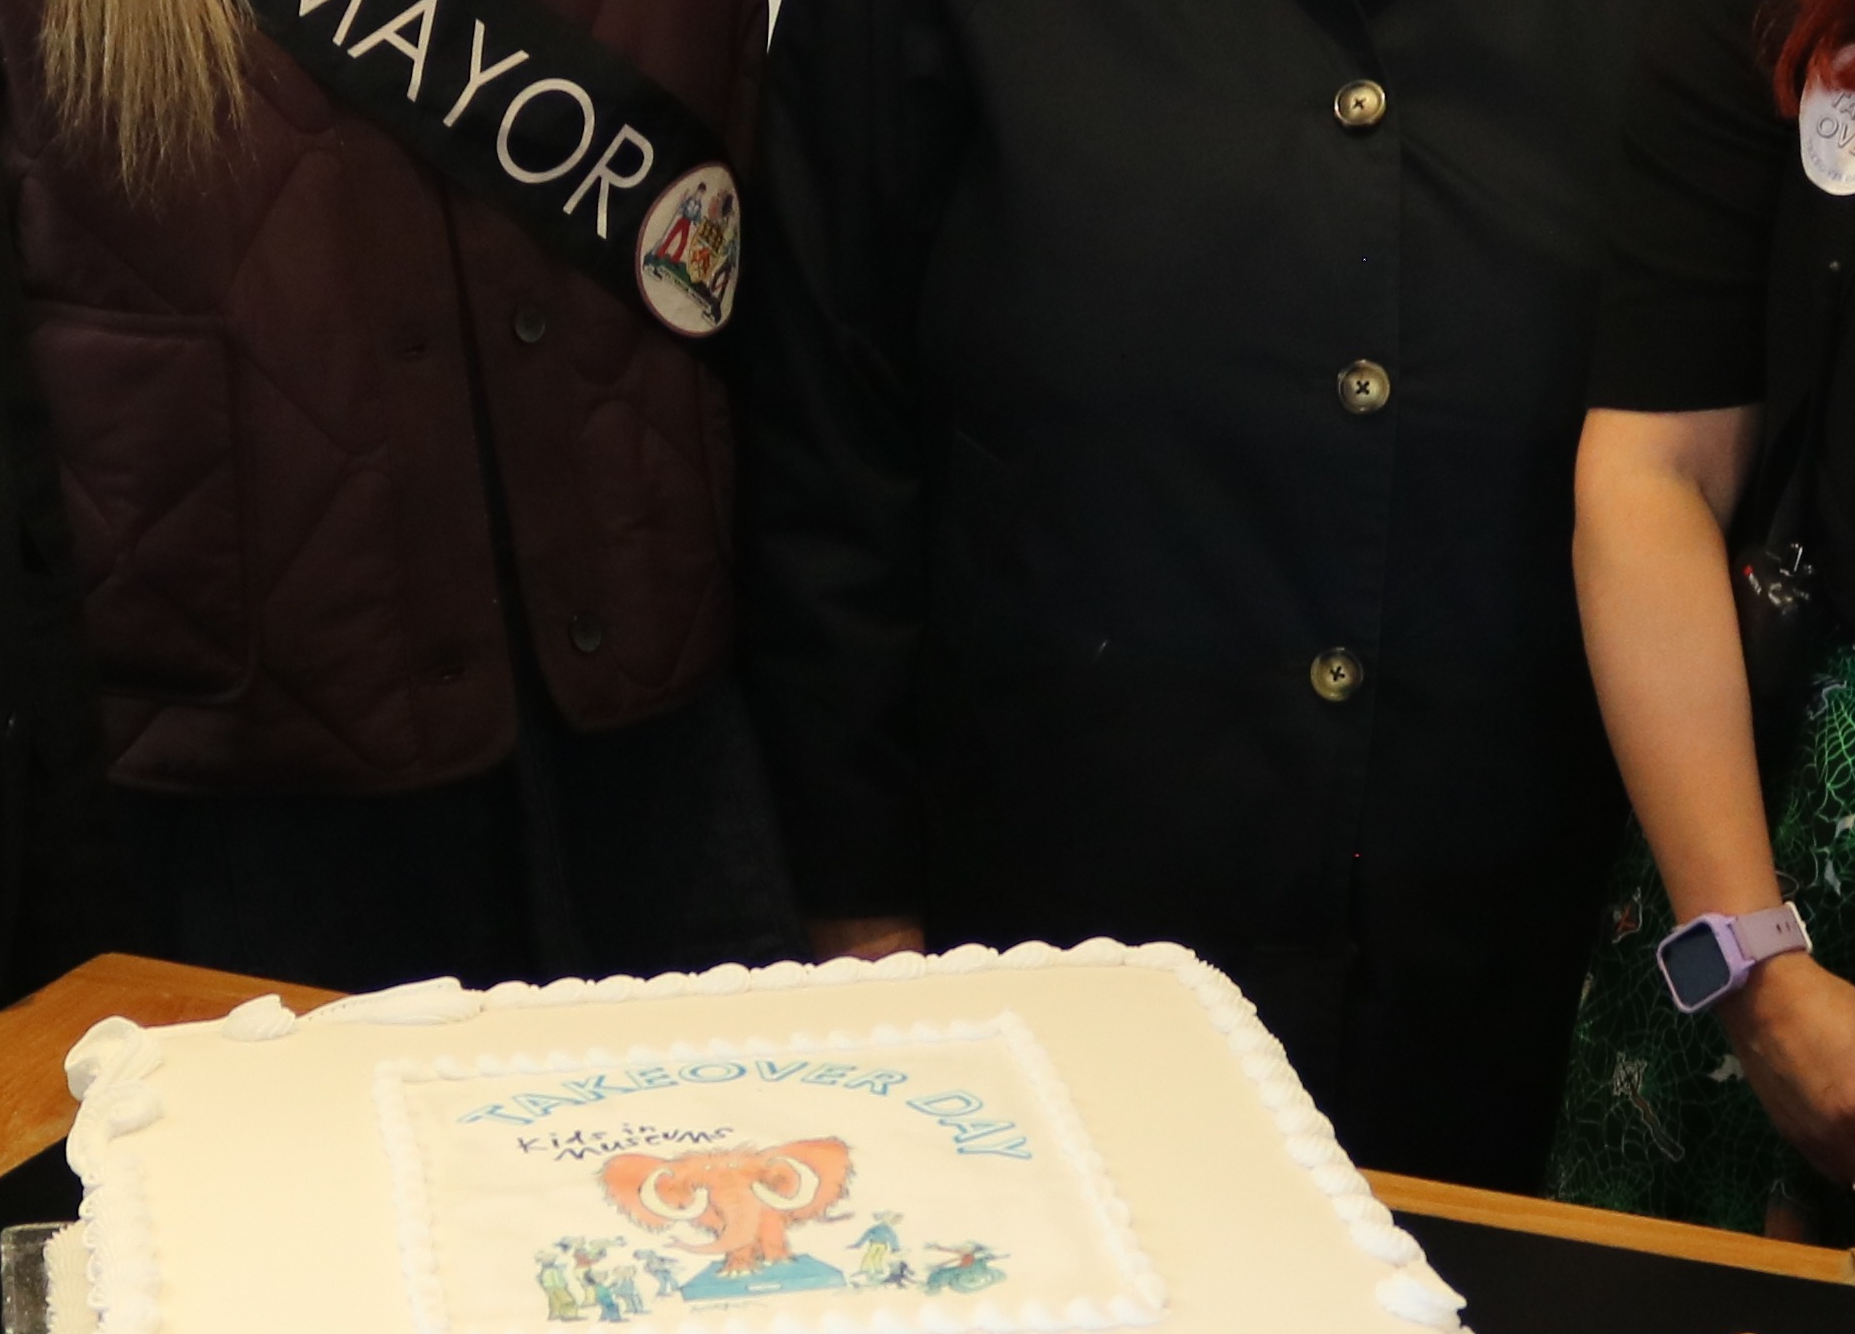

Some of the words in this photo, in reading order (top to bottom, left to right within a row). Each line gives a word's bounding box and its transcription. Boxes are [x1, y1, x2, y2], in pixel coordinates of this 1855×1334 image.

[456, 1060, 908, 1125] TAKEOVER
[906, 1091, 1033, 1159] DAY
[517, 1130, 606, 1153] Kids
[623, 1123, 657, 1135] in
